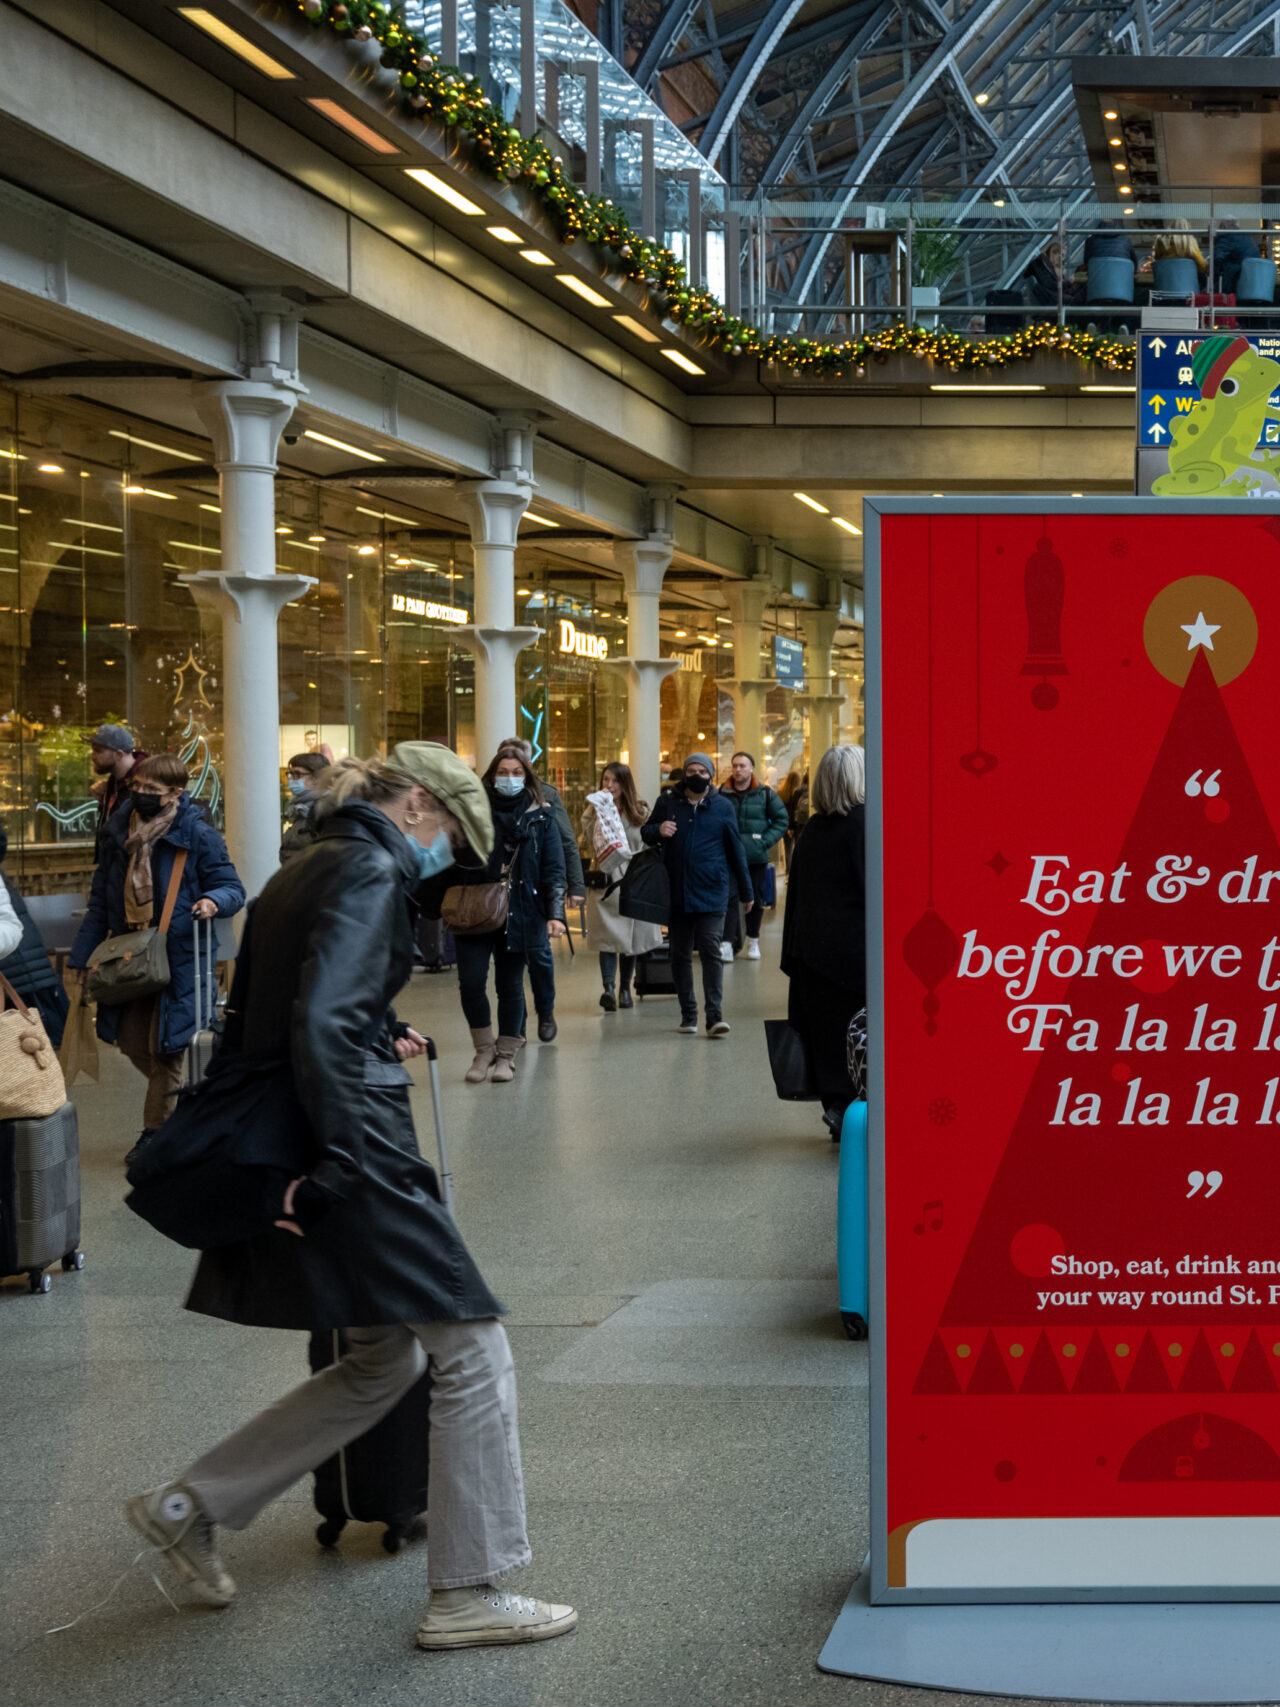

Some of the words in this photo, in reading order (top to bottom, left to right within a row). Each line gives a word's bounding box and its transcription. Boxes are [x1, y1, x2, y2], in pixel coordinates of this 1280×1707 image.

[1175, 340, 1193, 355] Al
[1259, 348, 1274, 357] and
[392, 594, 405, 611] LE
[559, 618, 609, 661] Dune
[1019, 855, 1133, 917] Eat
[1146, 854, 1211, 904] &
[956, 928, 1144, 1001] before
[1161, 944, 1243, 978] we
[1006, 1004, 1100, 1052] Fa
[1115, 1002, 1169, 1052] la
[1184, 1002, 1238, 1052] la
[1048, 1077, 1102, 1126] la
[1117, 1076, 1171, 1126] la
[1186, 1076, 1240, 1126] la
[1050, 1254, 1120, 1280] Shop,
[1126, 1257, 1170, 1279] eat,
[1175, 1254, 1243, 1275] drink
[1036, 1289, 1093, 1311] your
[1097, 1290, 1146, 1310] way
[1150, 1284, 1224, 1306] round
[1229, 1284, 1263, 1305] St.
